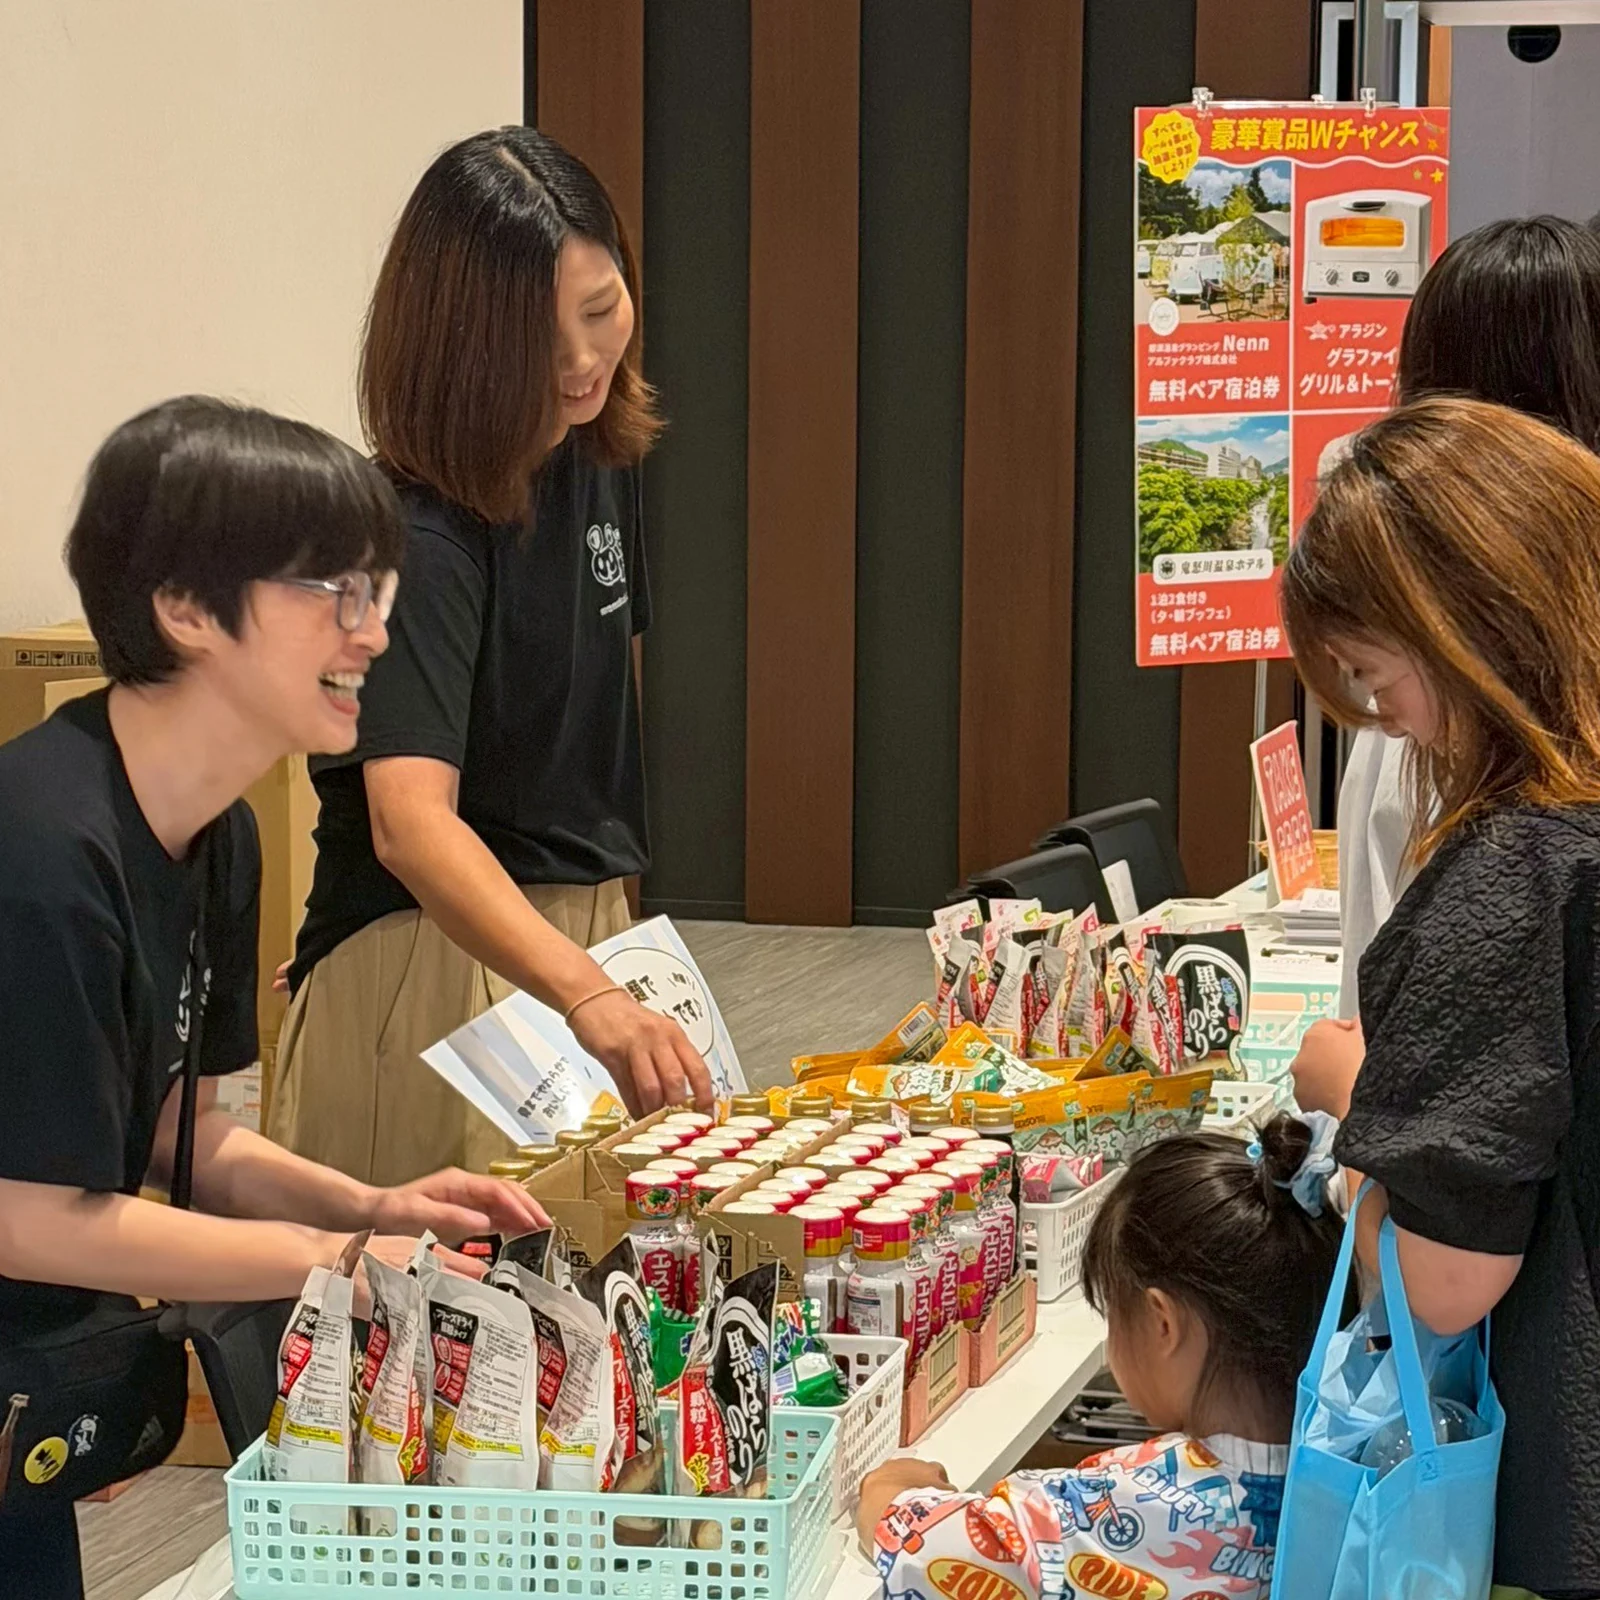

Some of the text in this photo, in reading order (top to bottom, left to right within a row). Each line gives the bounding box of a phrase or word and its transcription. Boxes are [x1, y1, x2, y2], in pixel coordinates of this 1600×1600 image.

[1211, 117, 1420, 151] 豪華賞品Wチャンス
[1223, 334, 1270, 352] Nenn
[1338, 322, 1388, 339] アラジン
[1148, 376, 1280, 403] 無料ペア宿泊券
[1149, 626, 1280, 657] 無料ペア宿泊券
[1195, 963, 1228, 1044] 黒ばら
[725, 1326, 767, 1453] 黒ばら
[726, 1404, 754, 1486] のり
[1132, 1465, 1215, 1524] BLUEY
